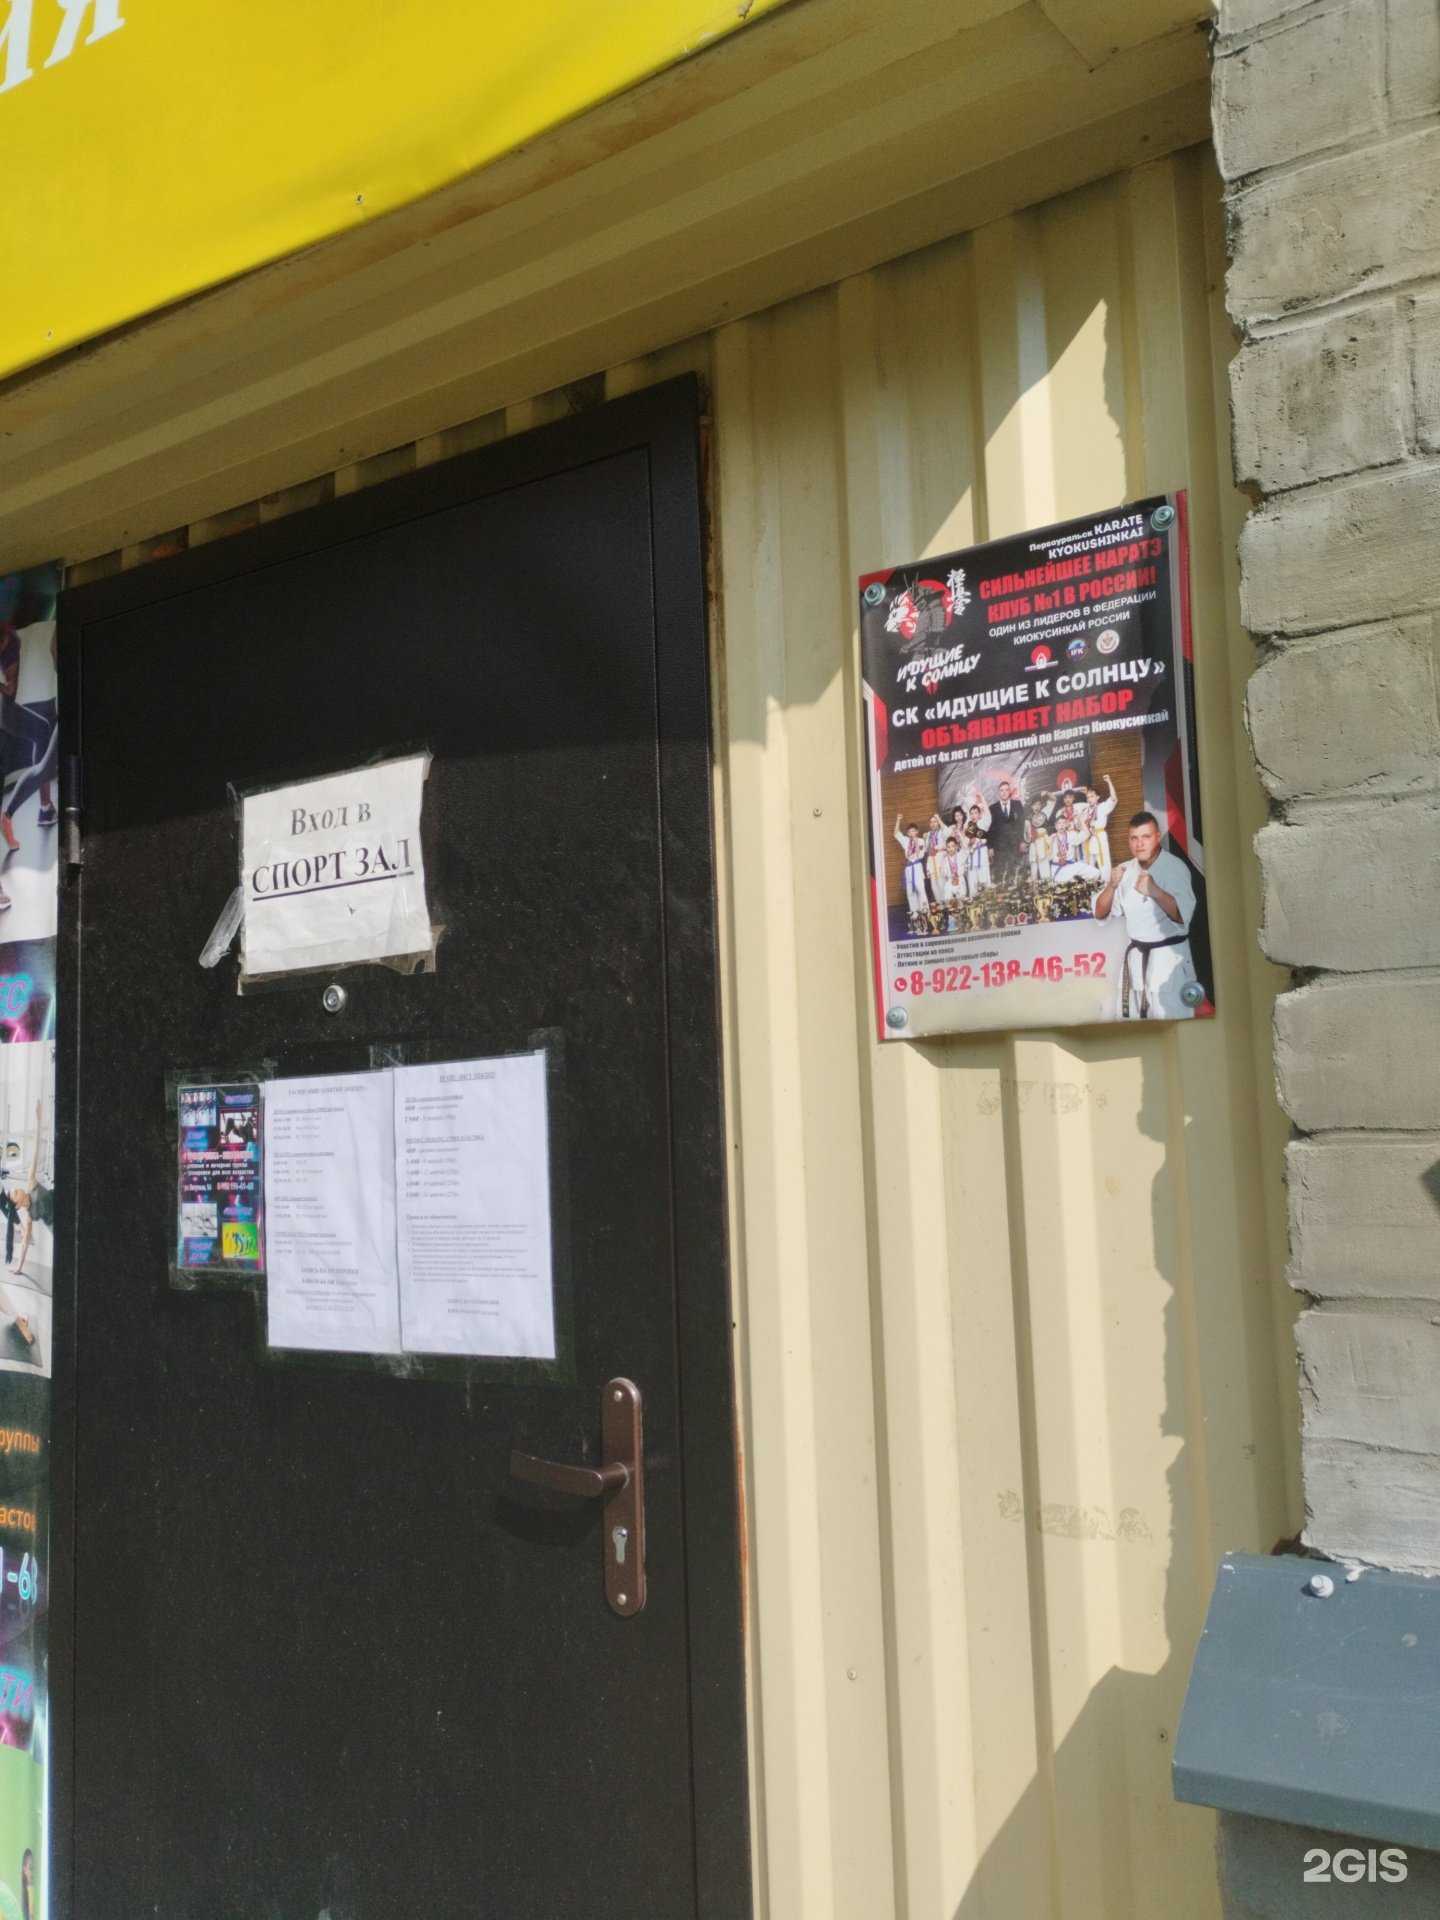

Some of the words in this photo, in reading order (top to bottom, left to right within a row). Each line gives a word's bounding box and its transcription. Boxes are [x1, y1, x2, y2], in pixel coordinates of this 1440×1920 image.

[1049, 527, 1144, 559] KYOKUSHINKAI
[1094, 514, 1144, 535] KARATE
[979, 554, 1092, 599] СИЛЬНЕЙШЕЕ
[1095, 537, 1162, 571] КАРАТЭ
[988, 596, 1031, 624] КЛУБ
[1064, 586, 1076, 605] В
[1079, 565, 1158, 600] РОССИИ!
[989, 623, 1016, 638] ОДИН
[1018, 619, 1031, 631] ИЗ
[1034, 608, 1080, 628] ЛИДЕРОВ
[1083, 604, 1091, 616] В
[1093, 591, 1157, 614] ФЕДЕРАЦИИ
[1013, 620, 1086, 646] КИОКУСИНКАЙ
[1088, 610, 1131, 628] РОССИИ
[897, 643, 965, 683] ИДУЩИЕ
[892, 706, 919, 727] СК
[925, 682, 1029, 720] «ИДУЩИЕ
[1035, 679, 1050, 699] К
[1056, 658, 1166, 694] СОЛНЦУ»
[894, 754, 924, 773] детей
[925, 753, 937, 765] от
[951, 749, 969, 760] лет
[971, 744, 992, 758] для
[993, 733, 1038, 752] занятий
[1039, 733, 1052, 744] по
[1092, 709, 1169, 733] Киокусинкай
[921, 706, 1051, 750] ОБЪЯВЛЯЕТ
[1055, 689, 1134, 724] НАБОР
[1052, 740, 1084, 754] KARATE
[290, 806, 348, 836] Вход
[358, 802, 372, 823] в
[252, 851, 346, 894] СПОРТ
[355, 839, 412, 877] ЗАЛ
[910, 951, 1106, 996] 8-922-138-46-52
